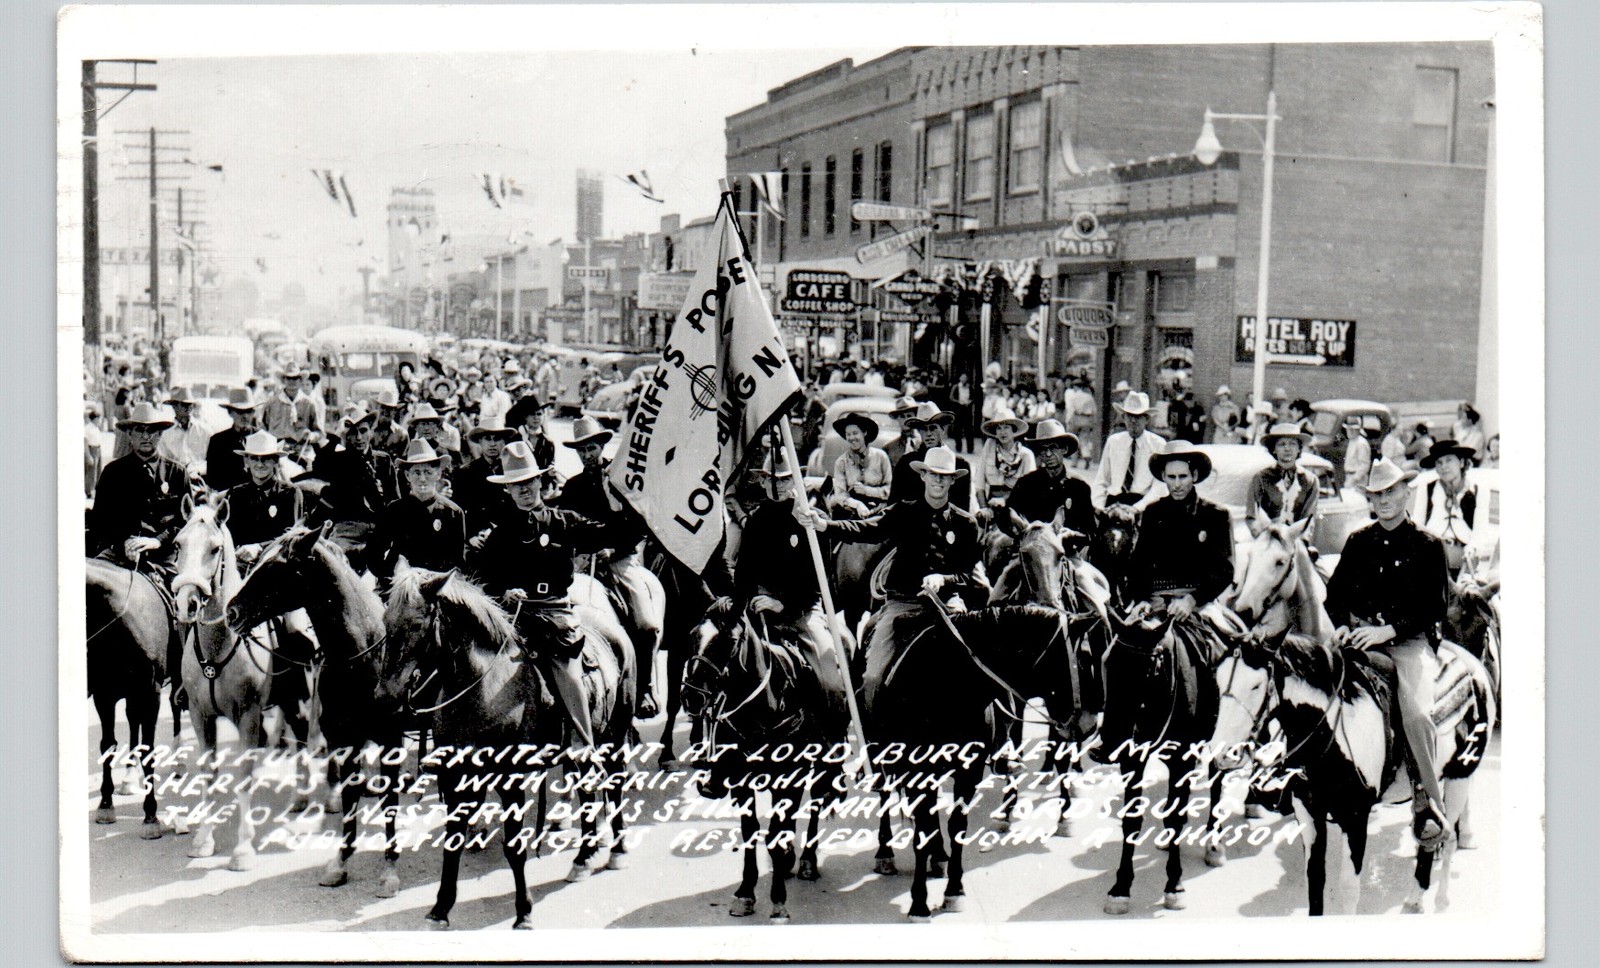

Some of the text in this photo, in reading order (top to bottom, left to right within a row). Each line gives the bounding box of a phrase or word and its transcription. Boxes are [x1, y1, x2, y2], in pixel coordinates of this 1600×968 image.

[1055, 240, 1116, 255] PABST
[795, 284, 845, 299] CAFE
[786, 299, 854, 312] COFFEE SHOP
[1064, 307, 1114, 327] LIQUORS
[1241, 317, 1350, 342] HTEL ROY
[1244, 337, 1287, 354] RTES
[1328, 341, 1347, 356] UP
